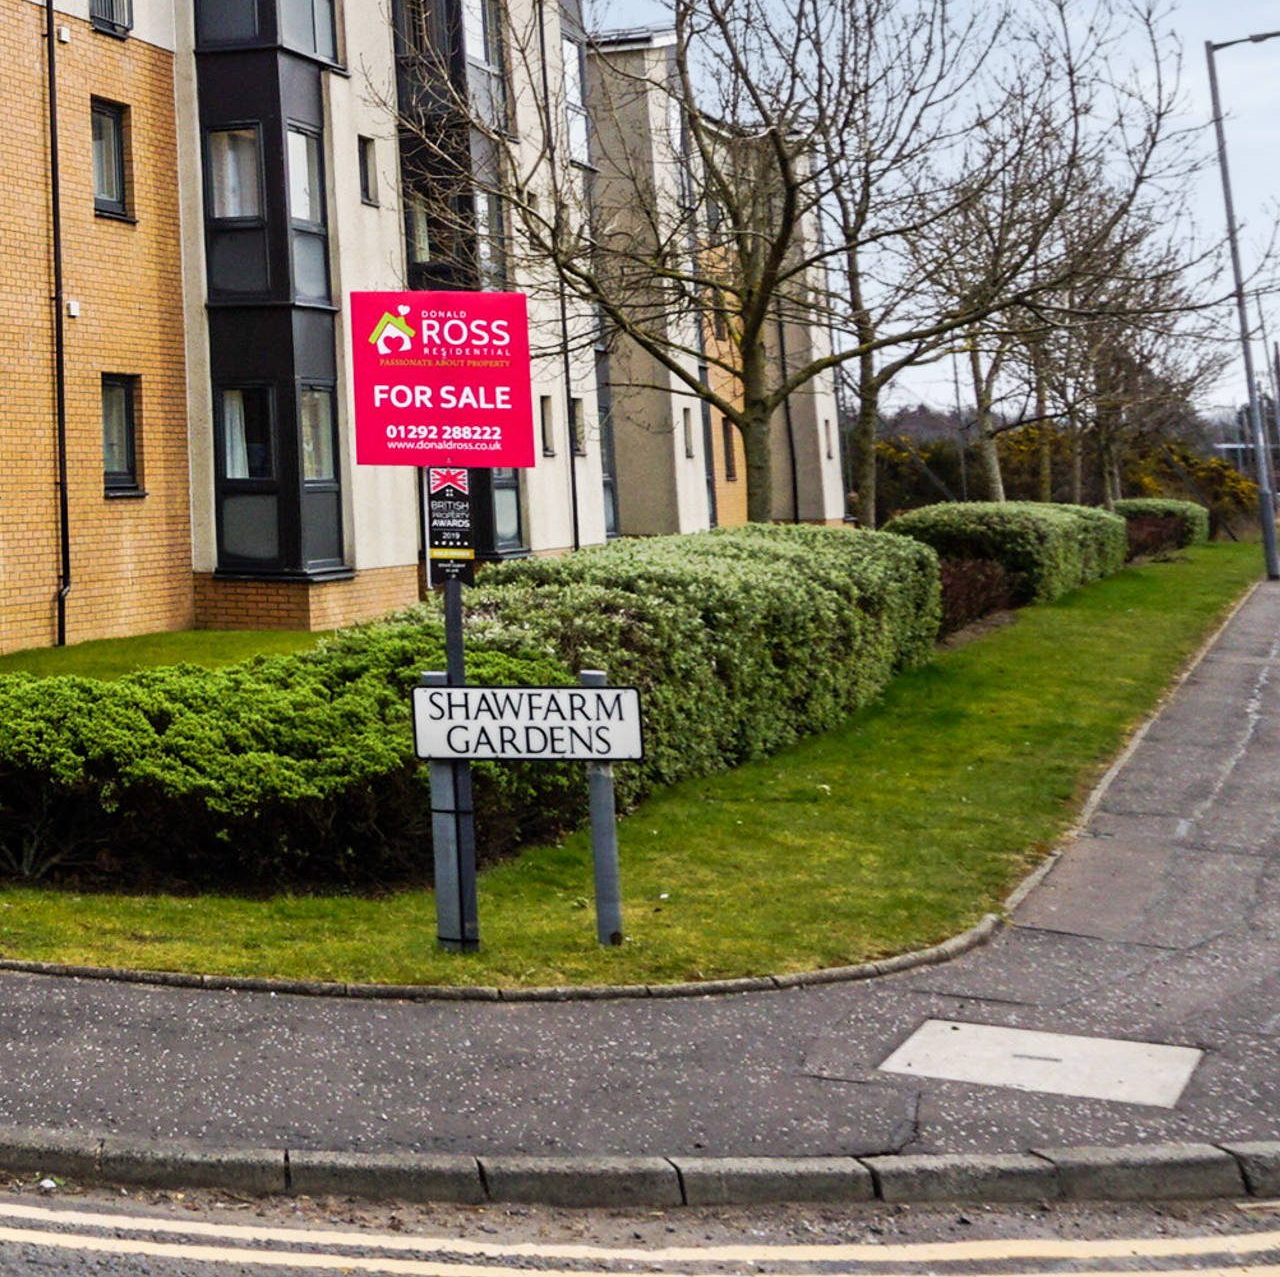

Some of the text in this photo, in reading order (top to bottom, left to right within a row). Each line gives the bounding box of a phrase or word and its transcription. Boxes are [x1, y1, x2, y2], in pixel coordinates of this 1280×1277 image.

[421, 310, 467, 318] DONALD
[421, 319, 511, 346] ROSS
[423, 347, 511, 357] RESIDENTIAL
[379, 358, 511, 368] PASSIONATE ABOUT PROPERTY
[373, 385, 512, 409] FOR SALE
[386, 425, 502, 440] 01292 288222
[386, 440, 503, 451] www.donaldross.co.uk
[430, 500, 470, 511] BRITISH
[431, 519, 471, 528] AWARDS
[428, 691, 625, 722] SHAWFARM
[446, 725, 613, 755] GARDENS
